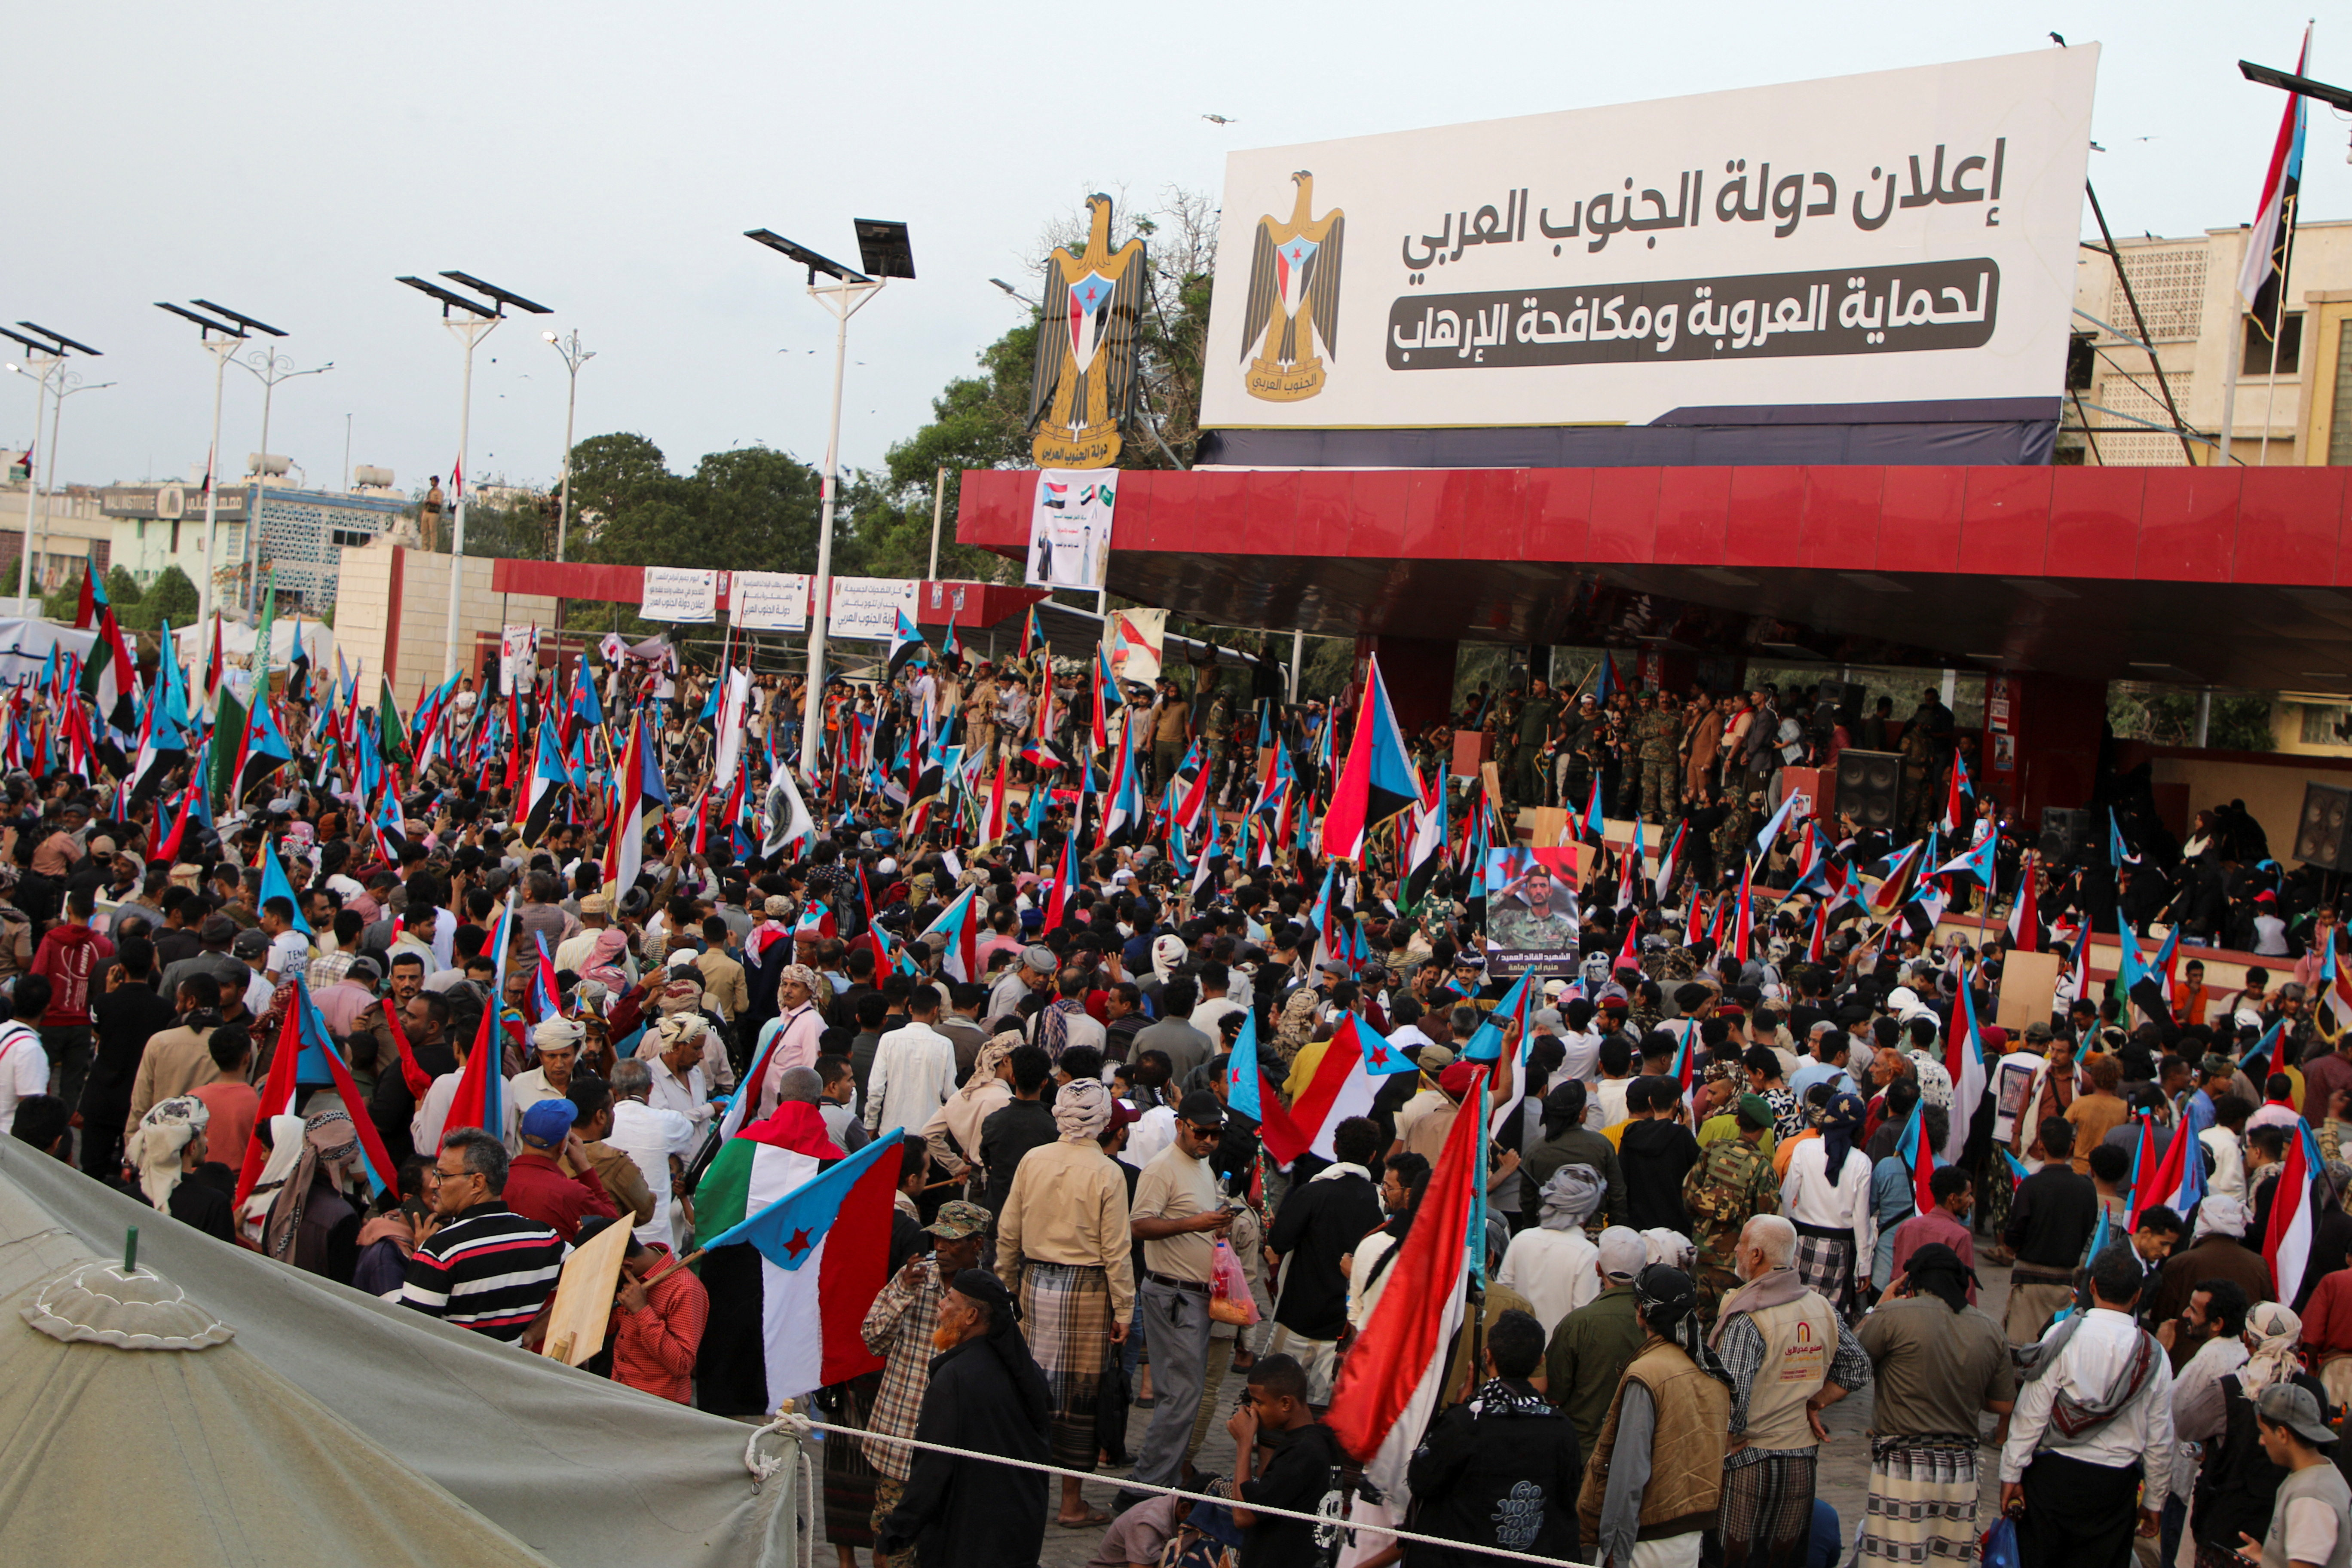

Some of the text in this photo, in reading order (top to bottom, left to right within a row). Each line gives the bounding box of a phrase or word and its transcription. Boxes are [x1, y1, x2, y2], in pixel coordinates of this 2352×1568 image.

[1403, 137, 2006, 286] إعلان دولة الجنوب العربي
[1393, 272, 1989, 362] لحماية العروبة ومكافحة الإرهاب
[1252, 373, 1317, 394] الجنوب العربي
[1042, 443, 1107, 466] دولة الجنوب العربي
[122, 495, 156, 510] INSTITUTE
[844, 584, 902, 595] كل التضحيات الجسيمة
[646, 597, 705, 613] إعلان دولة الجنوب العربي
[743, 603, 790, 618] دولة الجنوب العربي
[877, 597, 883, 609] أن
[837, 611, 894, 628] ولة الجنوب العربي
[1501, 953, 1523, 962] العميد
[1524, 953, 1543, 961] القائد
[1544, 952, 1571, 962] الشهيد
[1785, 1345, 1798, 1356] الأول
[1809, 1345, 1823, 1354] مصنع
[1510, 1480, 1542, 1501] Go
